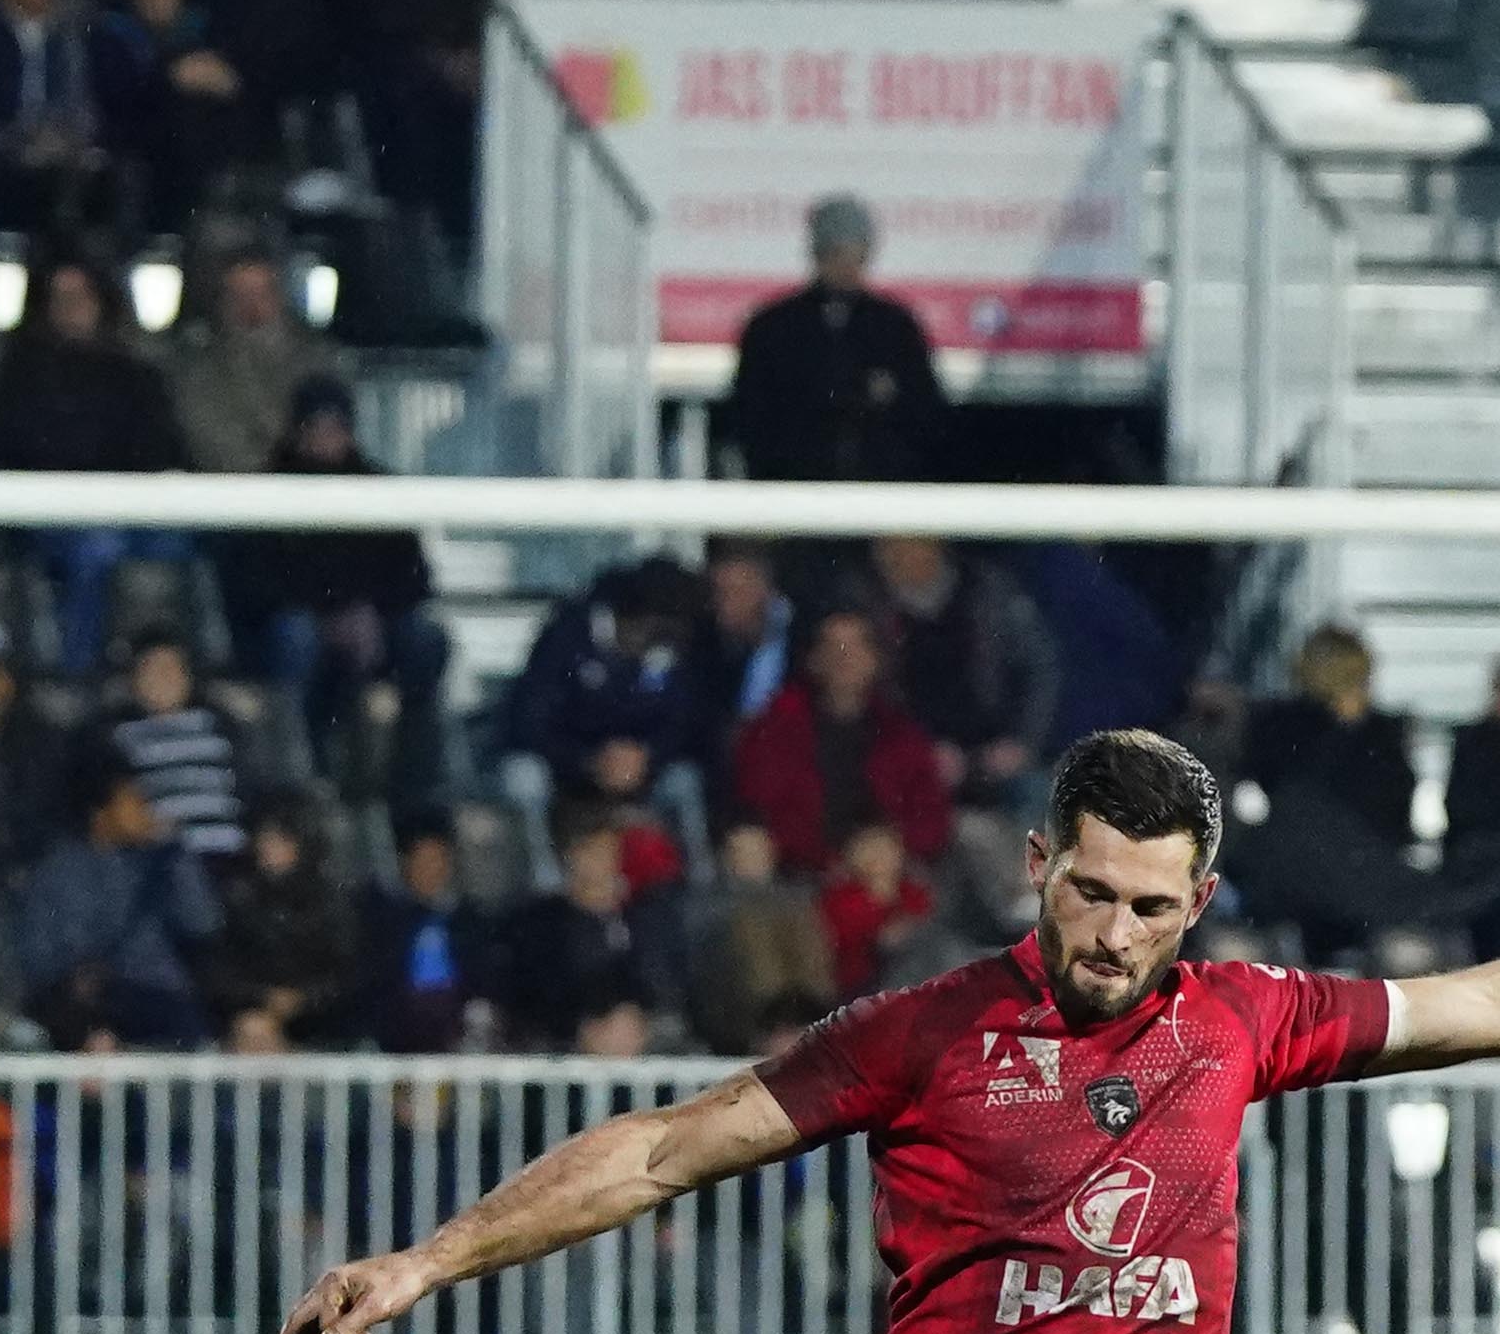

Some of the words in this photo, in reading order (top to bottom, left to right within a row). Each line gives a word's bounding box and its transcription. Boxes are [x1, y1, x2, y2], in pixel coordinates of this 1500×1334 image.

[781, 49, 849, 124] DE
[870, 51, 1119, 126] BOUFFAN
[994, 1255, 1200, 1327] HAFA
